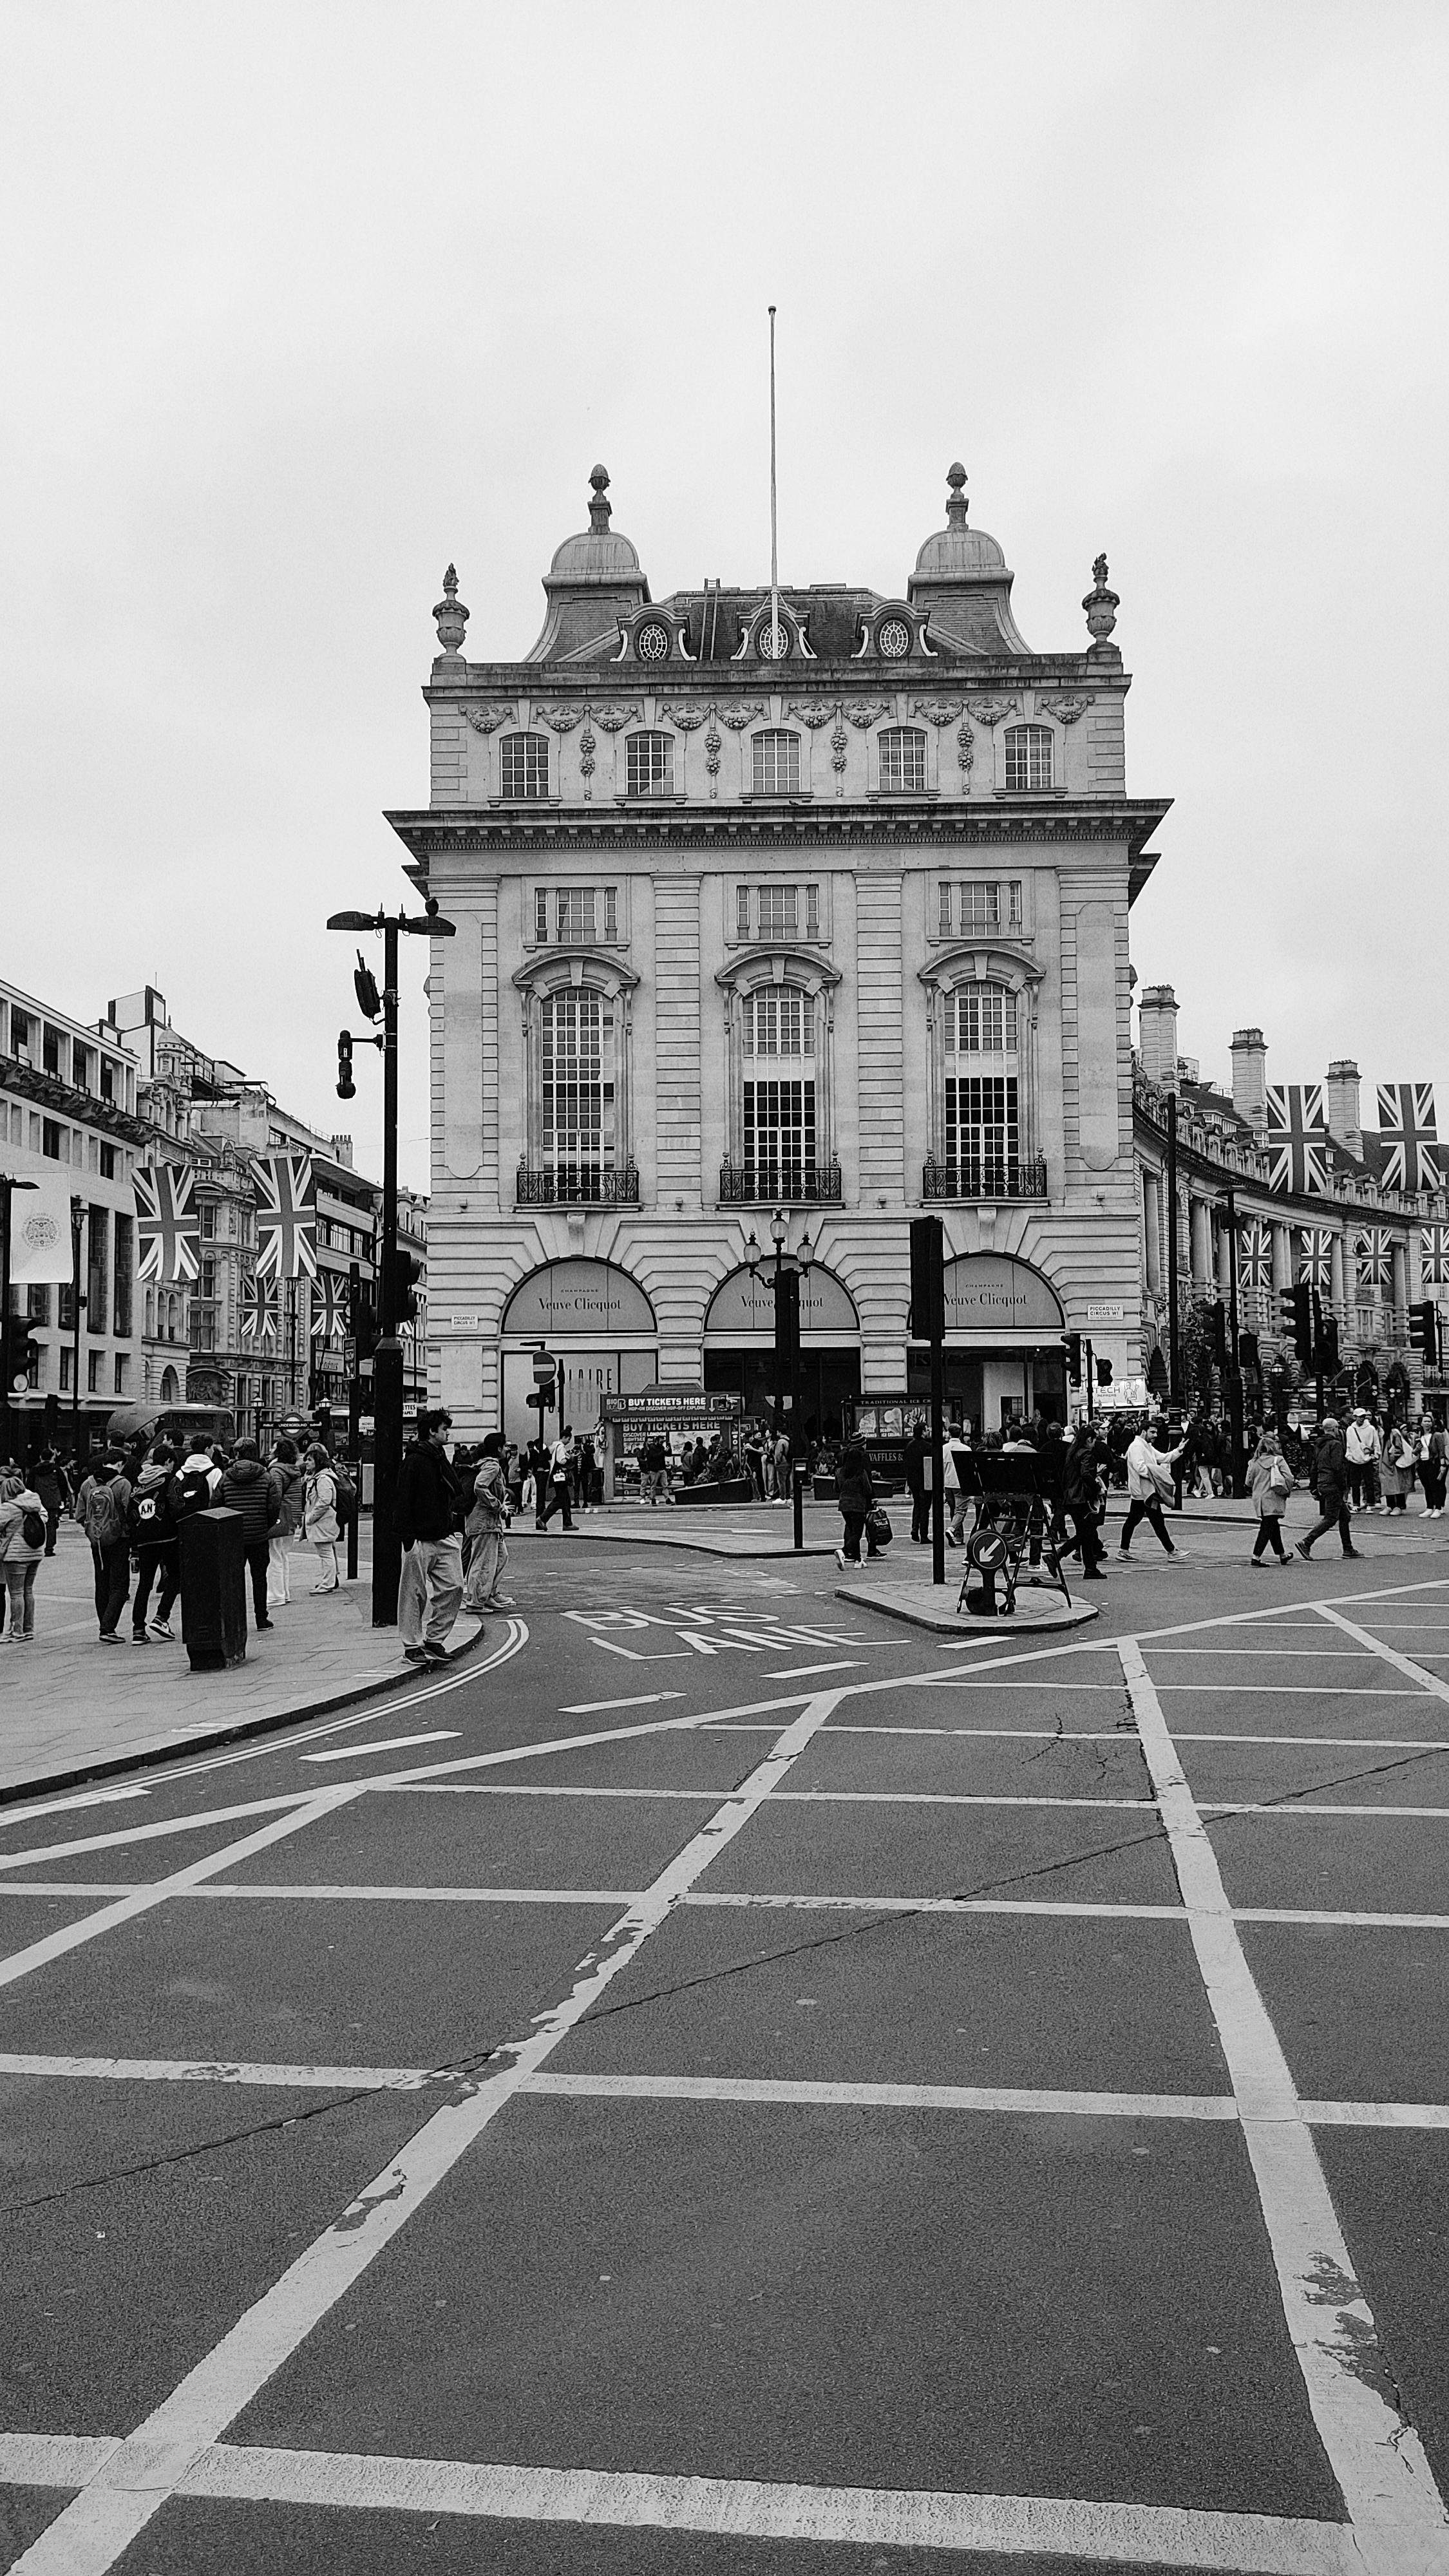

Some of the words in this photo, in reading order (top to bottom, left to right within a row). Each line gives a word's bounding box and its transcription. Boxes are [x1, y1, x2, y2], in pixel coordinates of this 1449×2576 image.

[538, 1297, 571, 1311] Veuve
[574, 1297, 621, 1312] Clicquot
[741, 1295, 773, 1308] Veuve
[800, 1297, 824, 1310] quot
[943, 1293, 976, 1306] Veuve
[980, 1293, 1028, 1308] Clicquot
[628, 1398, 645, 1406] BUY
[647, 1397, 682, 1406] TICKETS
[683, 1397, 706, 1405] HERE
[623, 1423, 643, 1432] BUY
[646, 1421, 690, 1431] TICKETS
[692, 1421, 721, 1430] HERE
[561, 1605, 781, 1631] BUS
[586, 1623, 912, 1660] LANE
